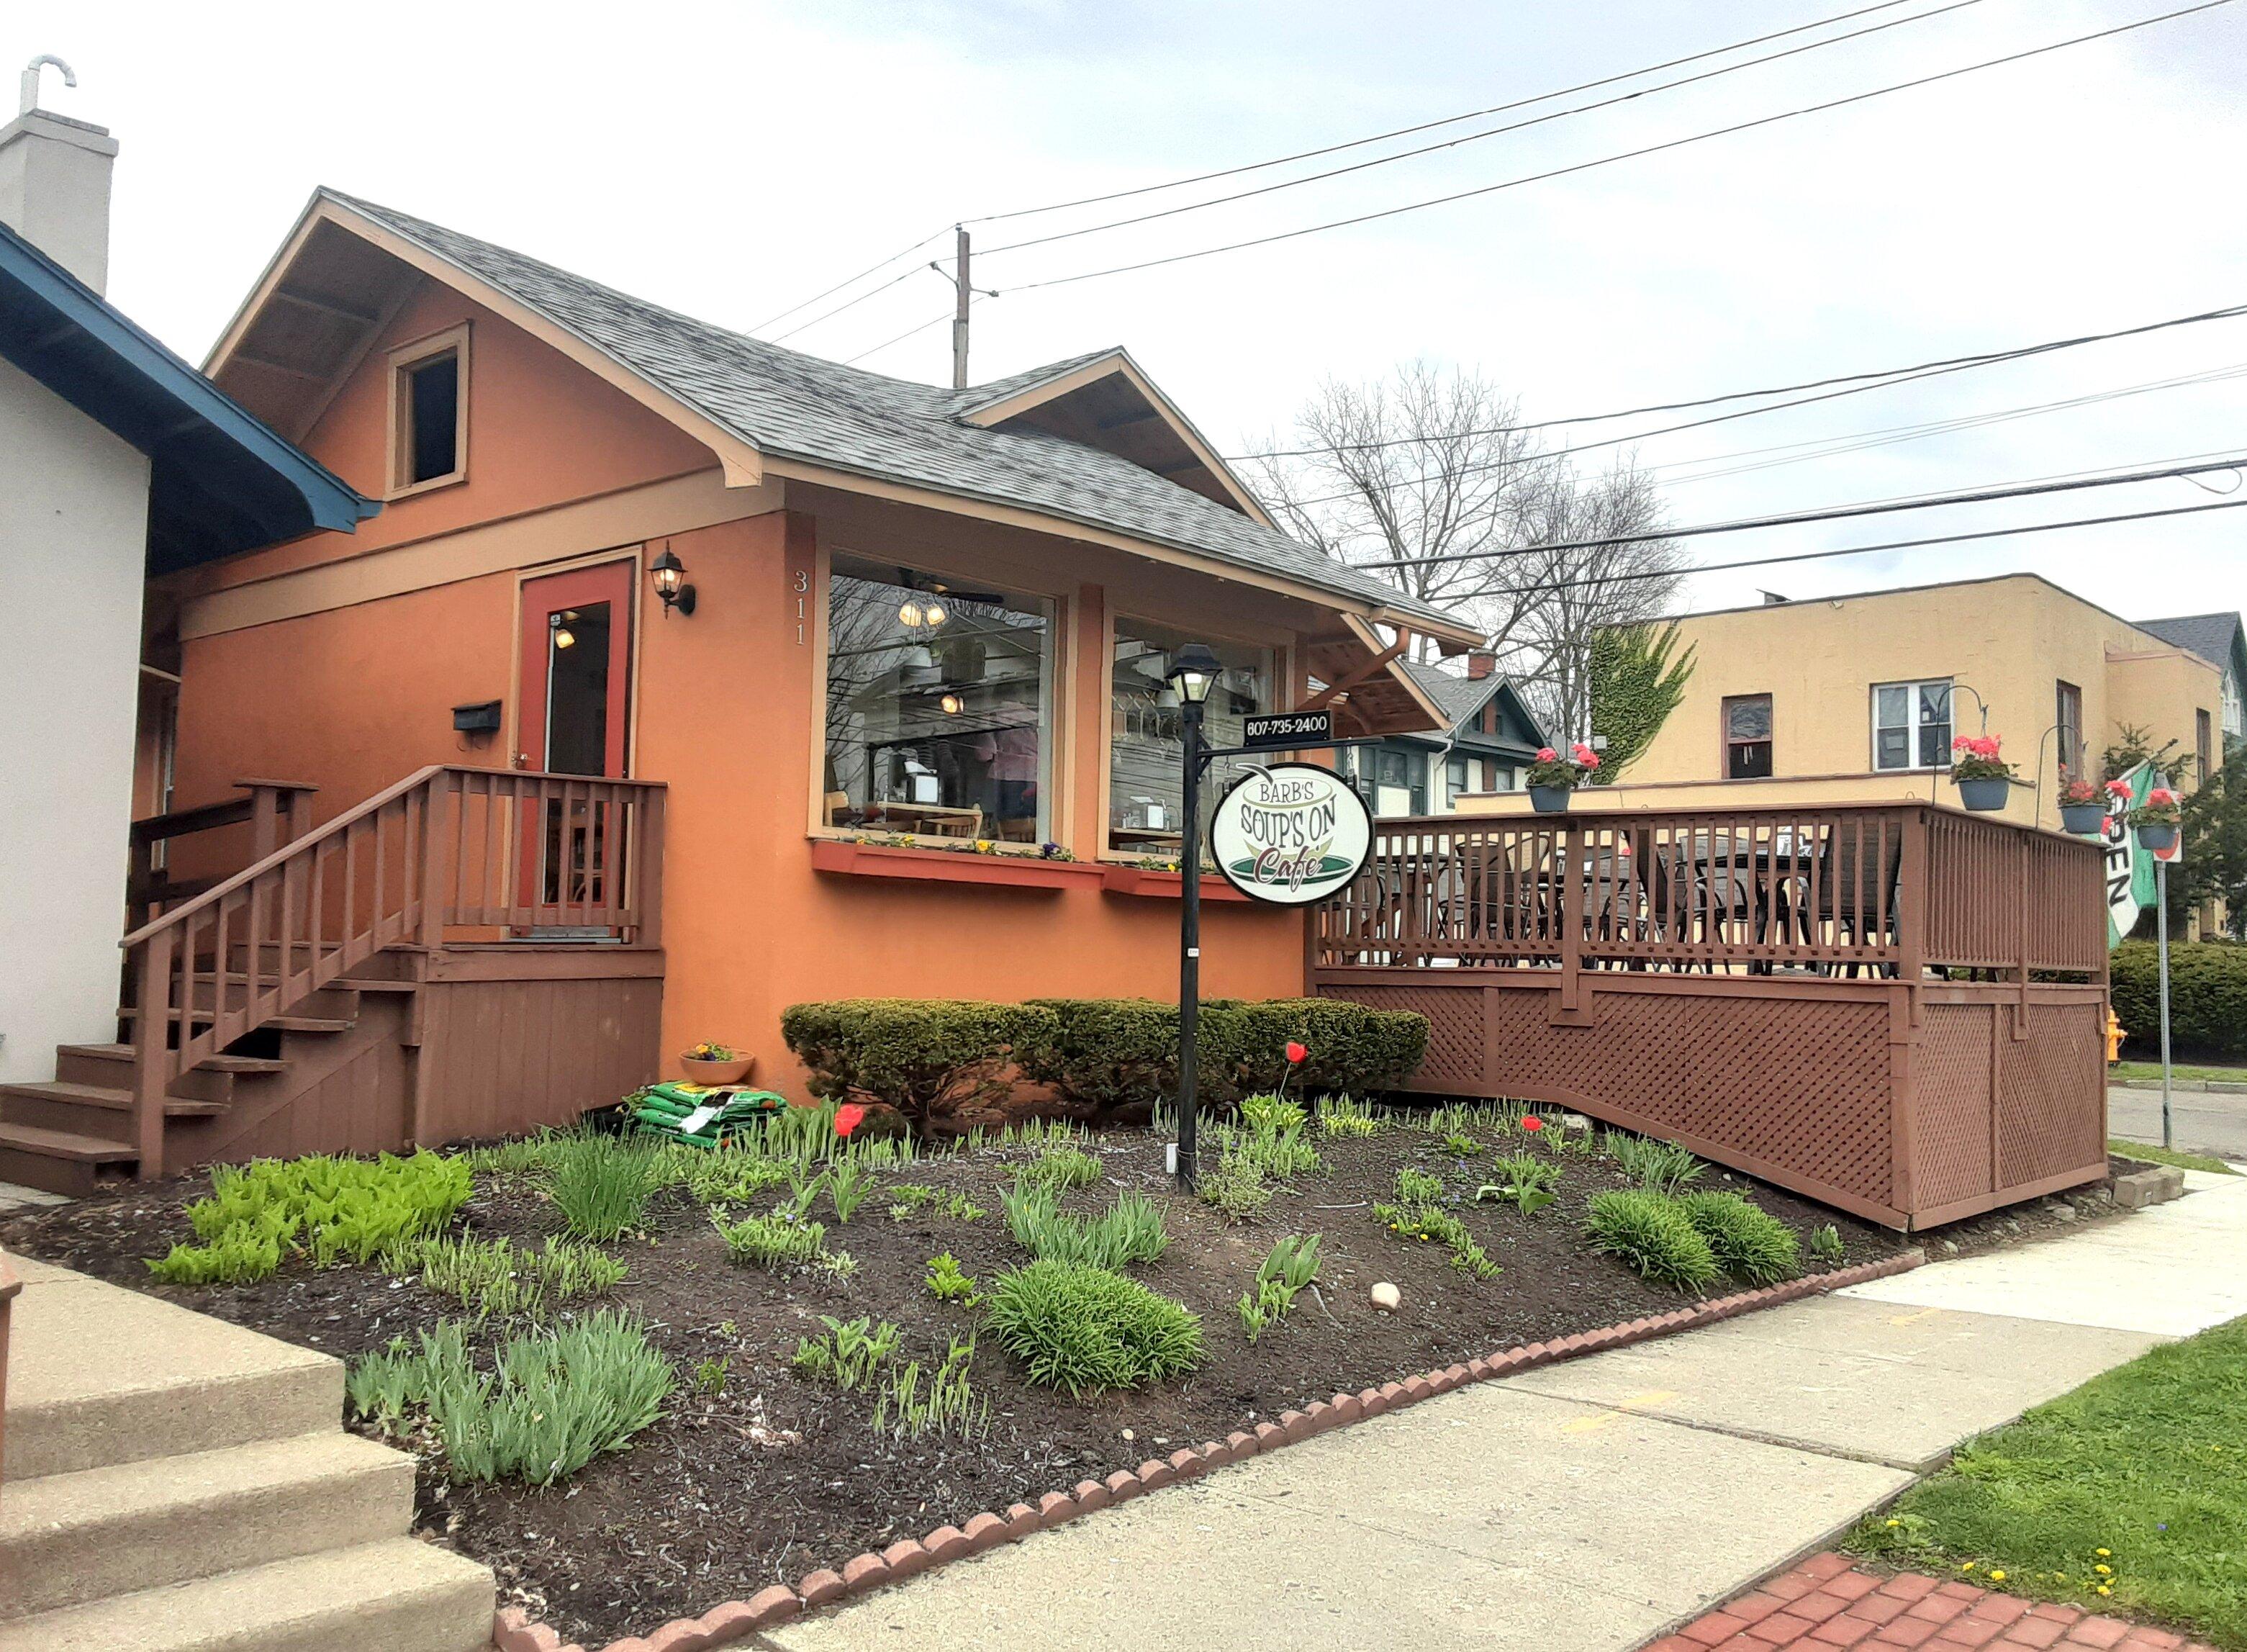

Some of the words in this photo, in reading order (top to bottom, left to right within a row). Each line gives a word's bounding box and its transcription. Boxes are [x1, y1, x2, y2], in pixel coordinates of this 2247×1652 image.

[794, 571, 807, 645] 311
[1247, 716, 1327, 736] 607-735-2400
[1260, 781, 1314, 803] BARB'S
[1241, 803, 1304, 849] SOUP'S
[1309, 793, 1337, 842] ON
